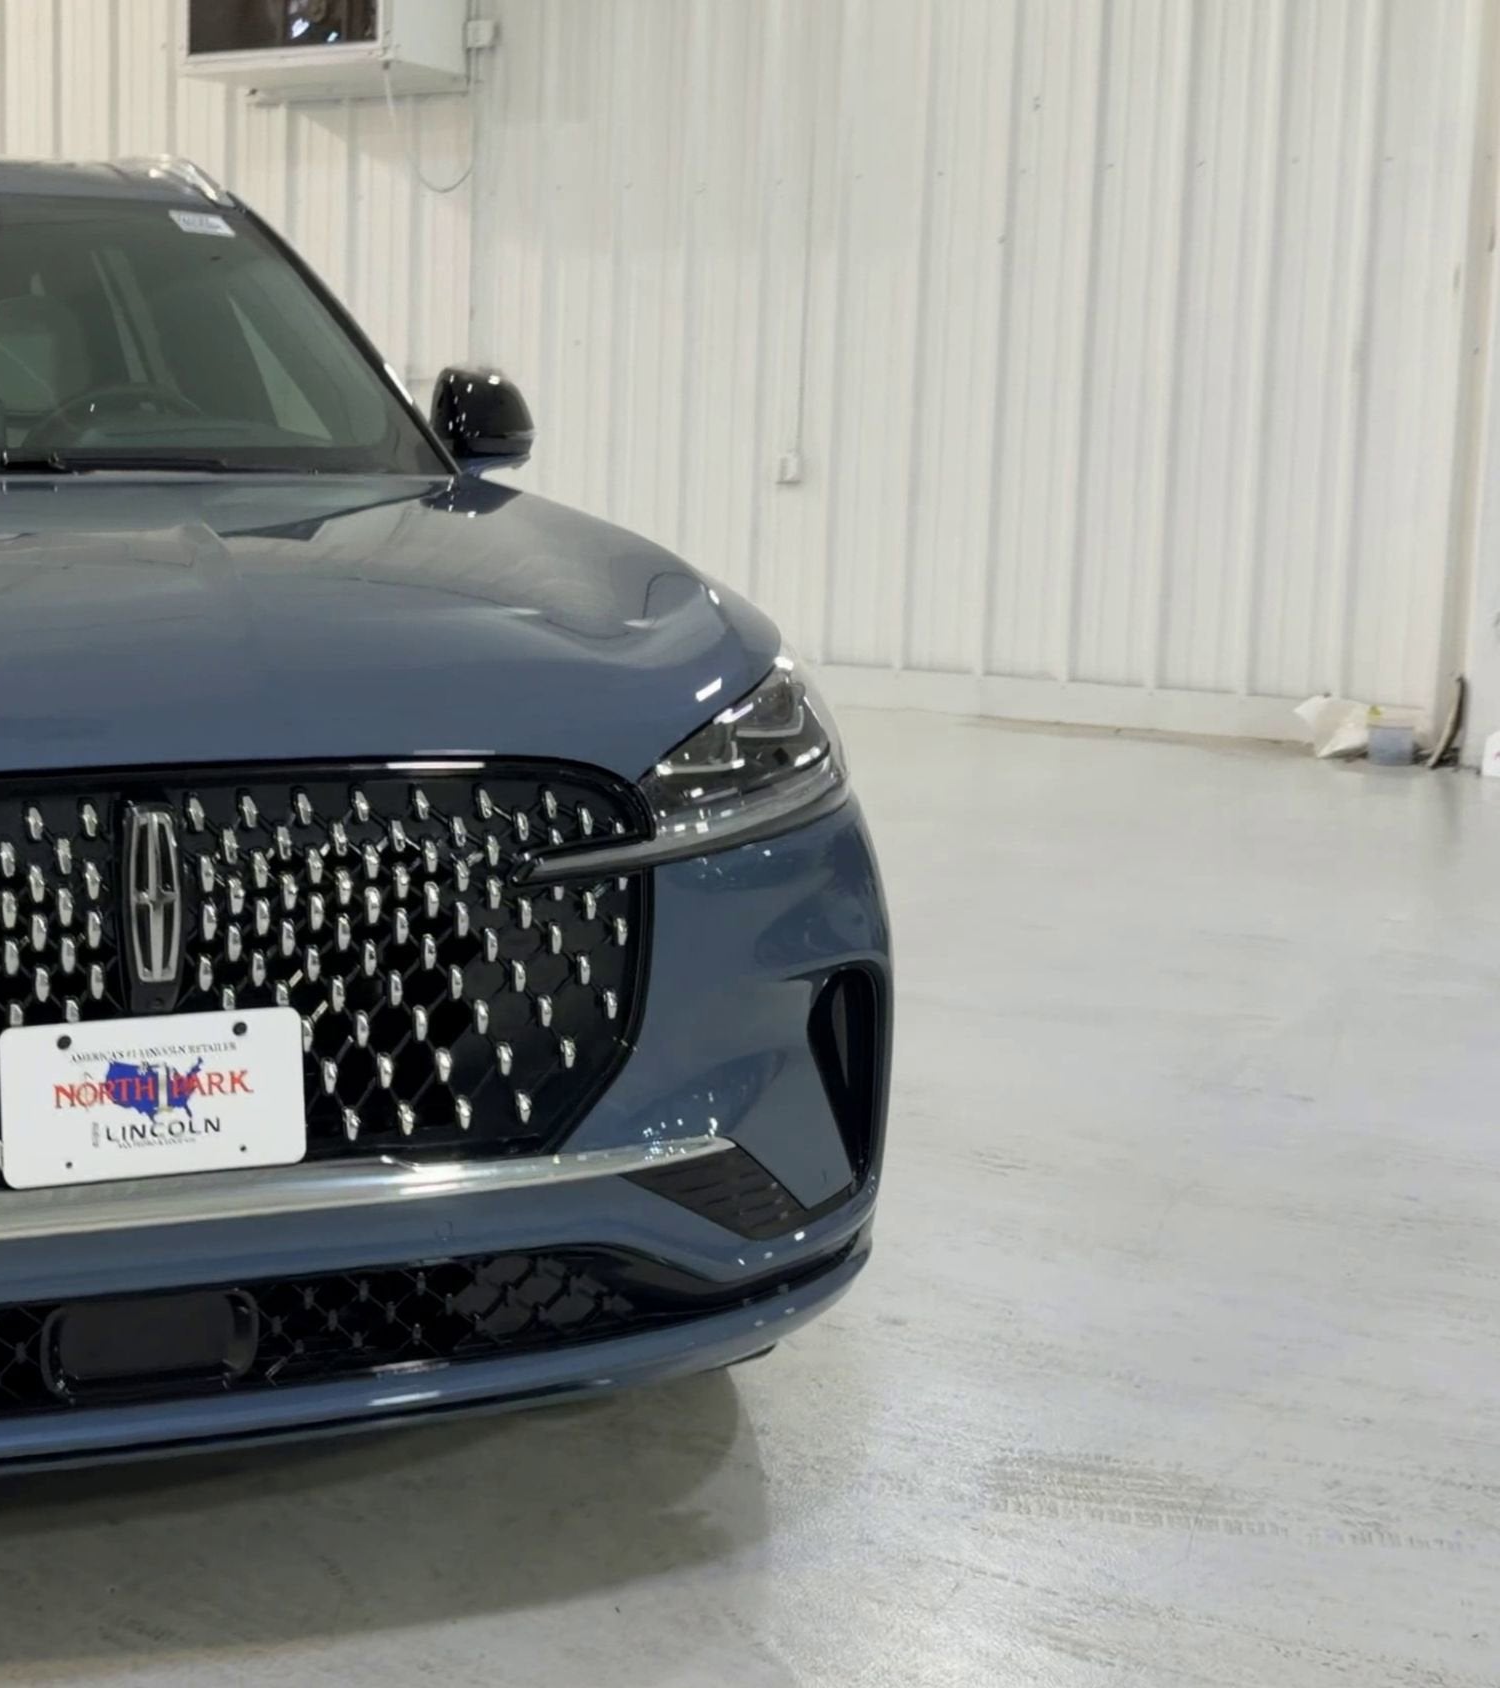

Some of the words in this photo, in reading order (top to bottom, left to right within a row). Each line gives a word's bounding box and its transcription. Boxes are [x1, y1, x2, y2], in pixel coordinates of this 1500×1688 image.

[53, 1075, 156, 1109] NORTH
[171, 1069, 255, 1099] PARK
[105, 1116, 221, 1143] LINCOLN
